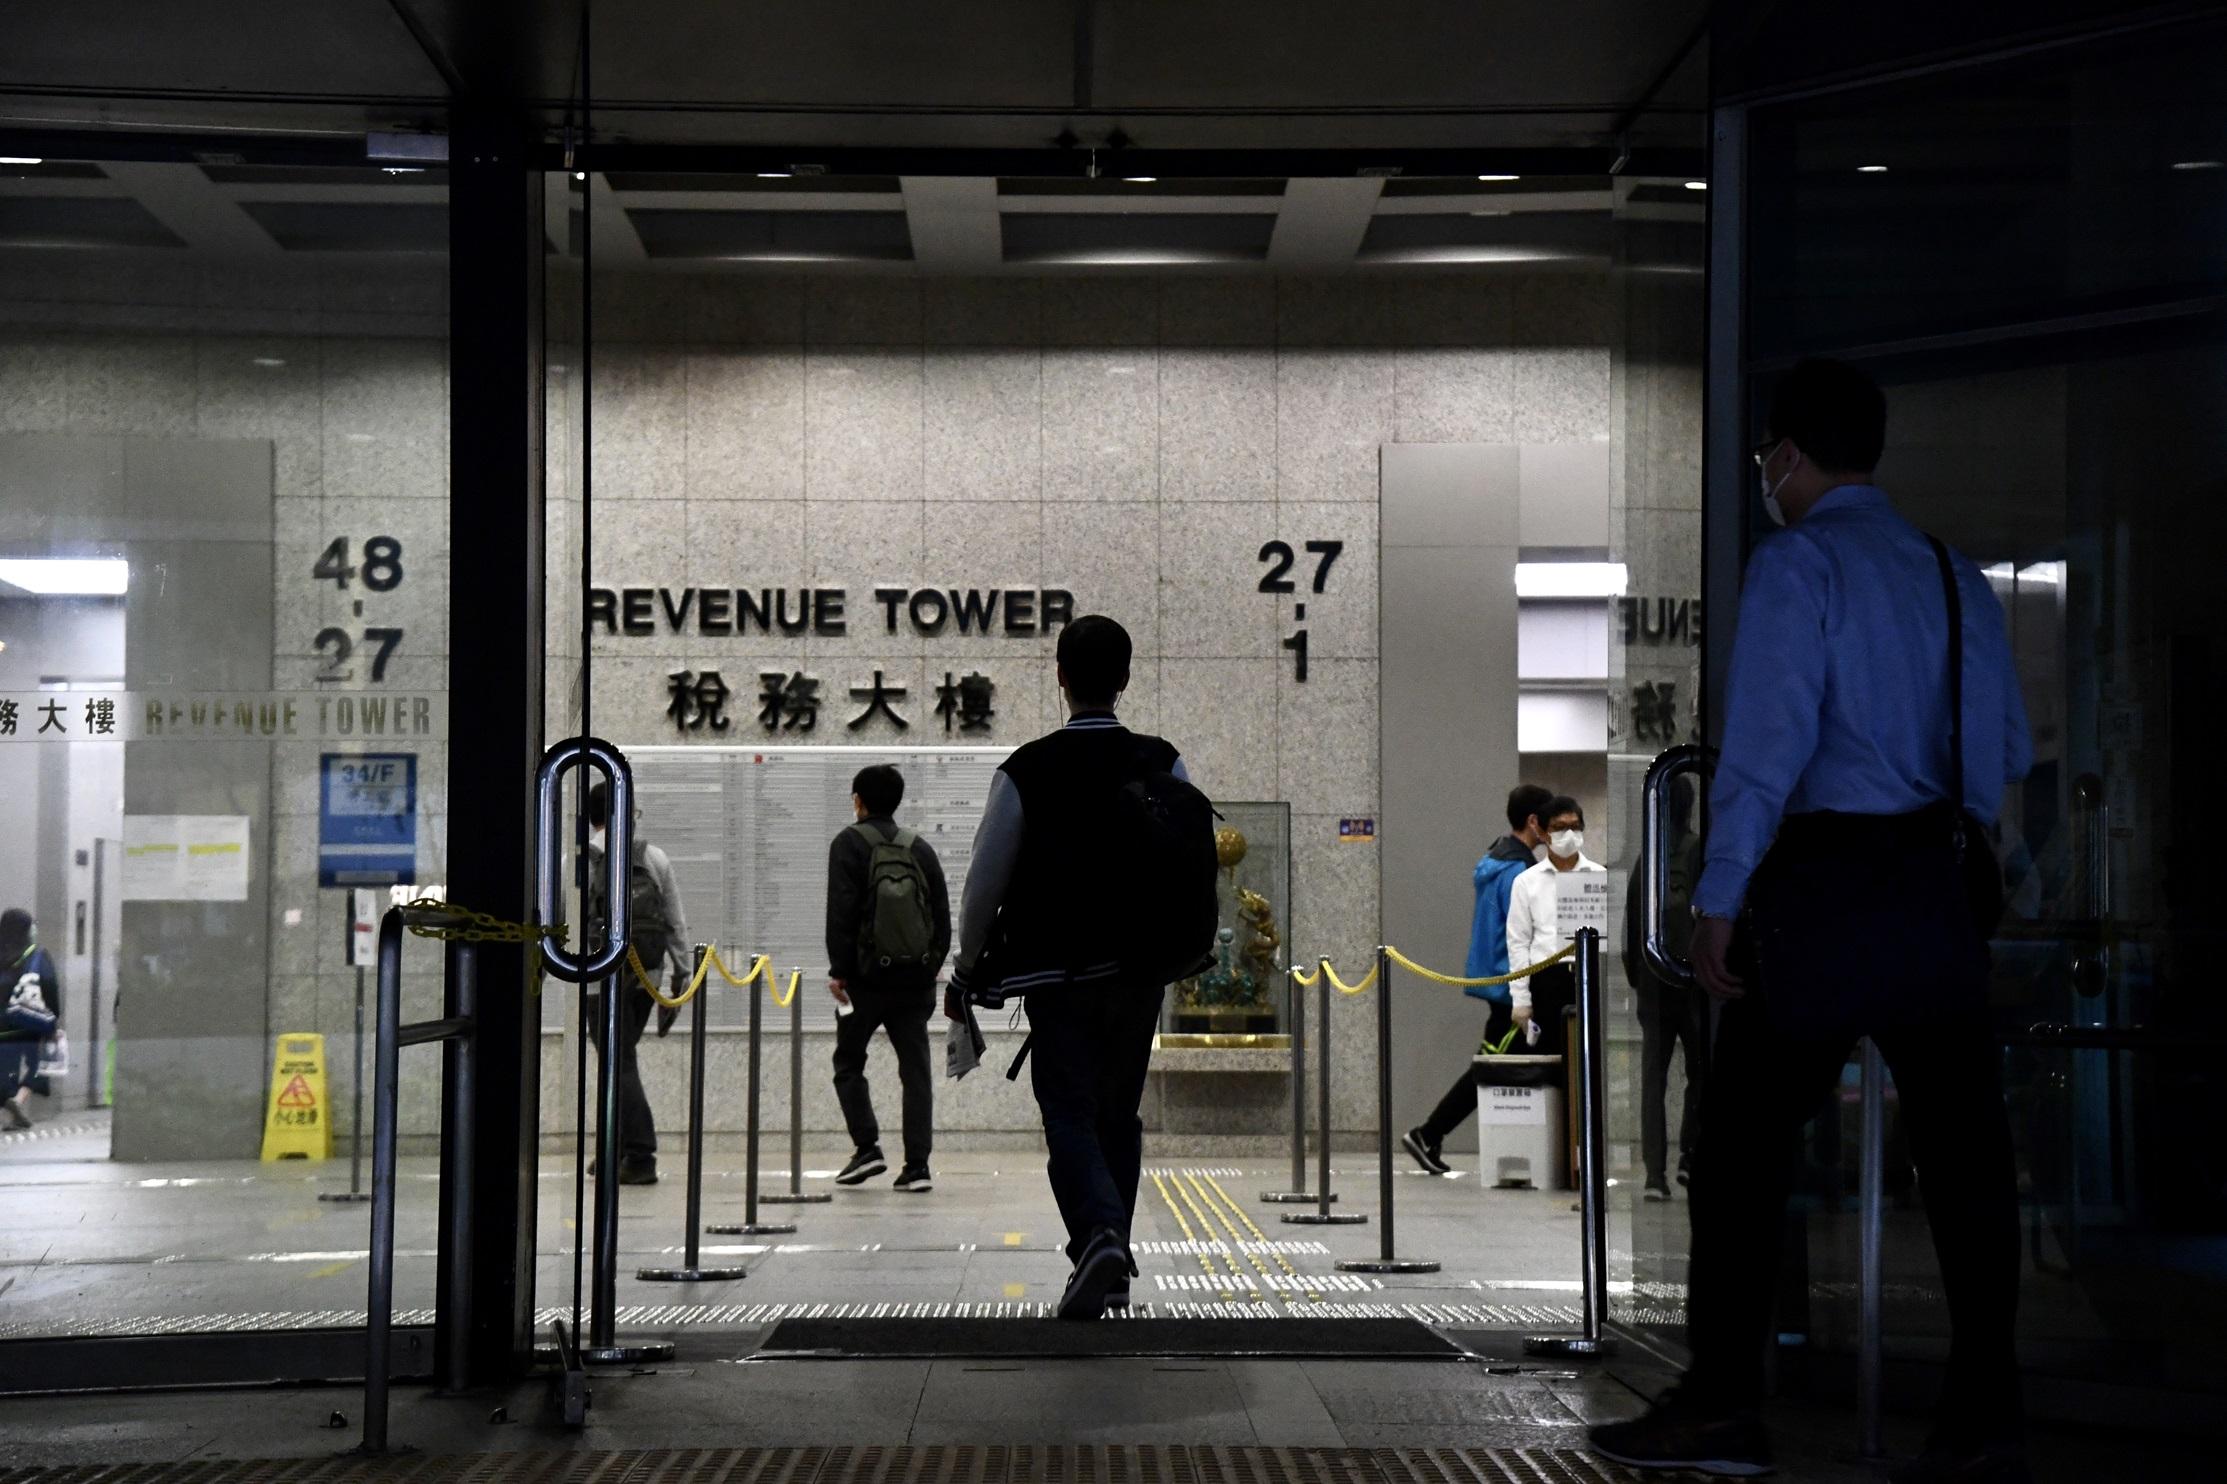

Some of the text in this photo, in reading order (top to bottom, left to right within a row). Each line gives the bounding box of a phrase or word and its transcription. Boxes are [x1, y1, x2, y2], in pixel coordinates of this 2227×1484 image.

[313, 535, 404, 593] 48
[1257, 540, 1344, 594] 27
[590, 587, 1076, 637] REVENUE TOWER
[313, 627, 404, 683] 27
[1282, 629, 1308, 683] 1
[145, 697, 298, 736] REVENUE
[315, 697, 431, 736] TOWER
